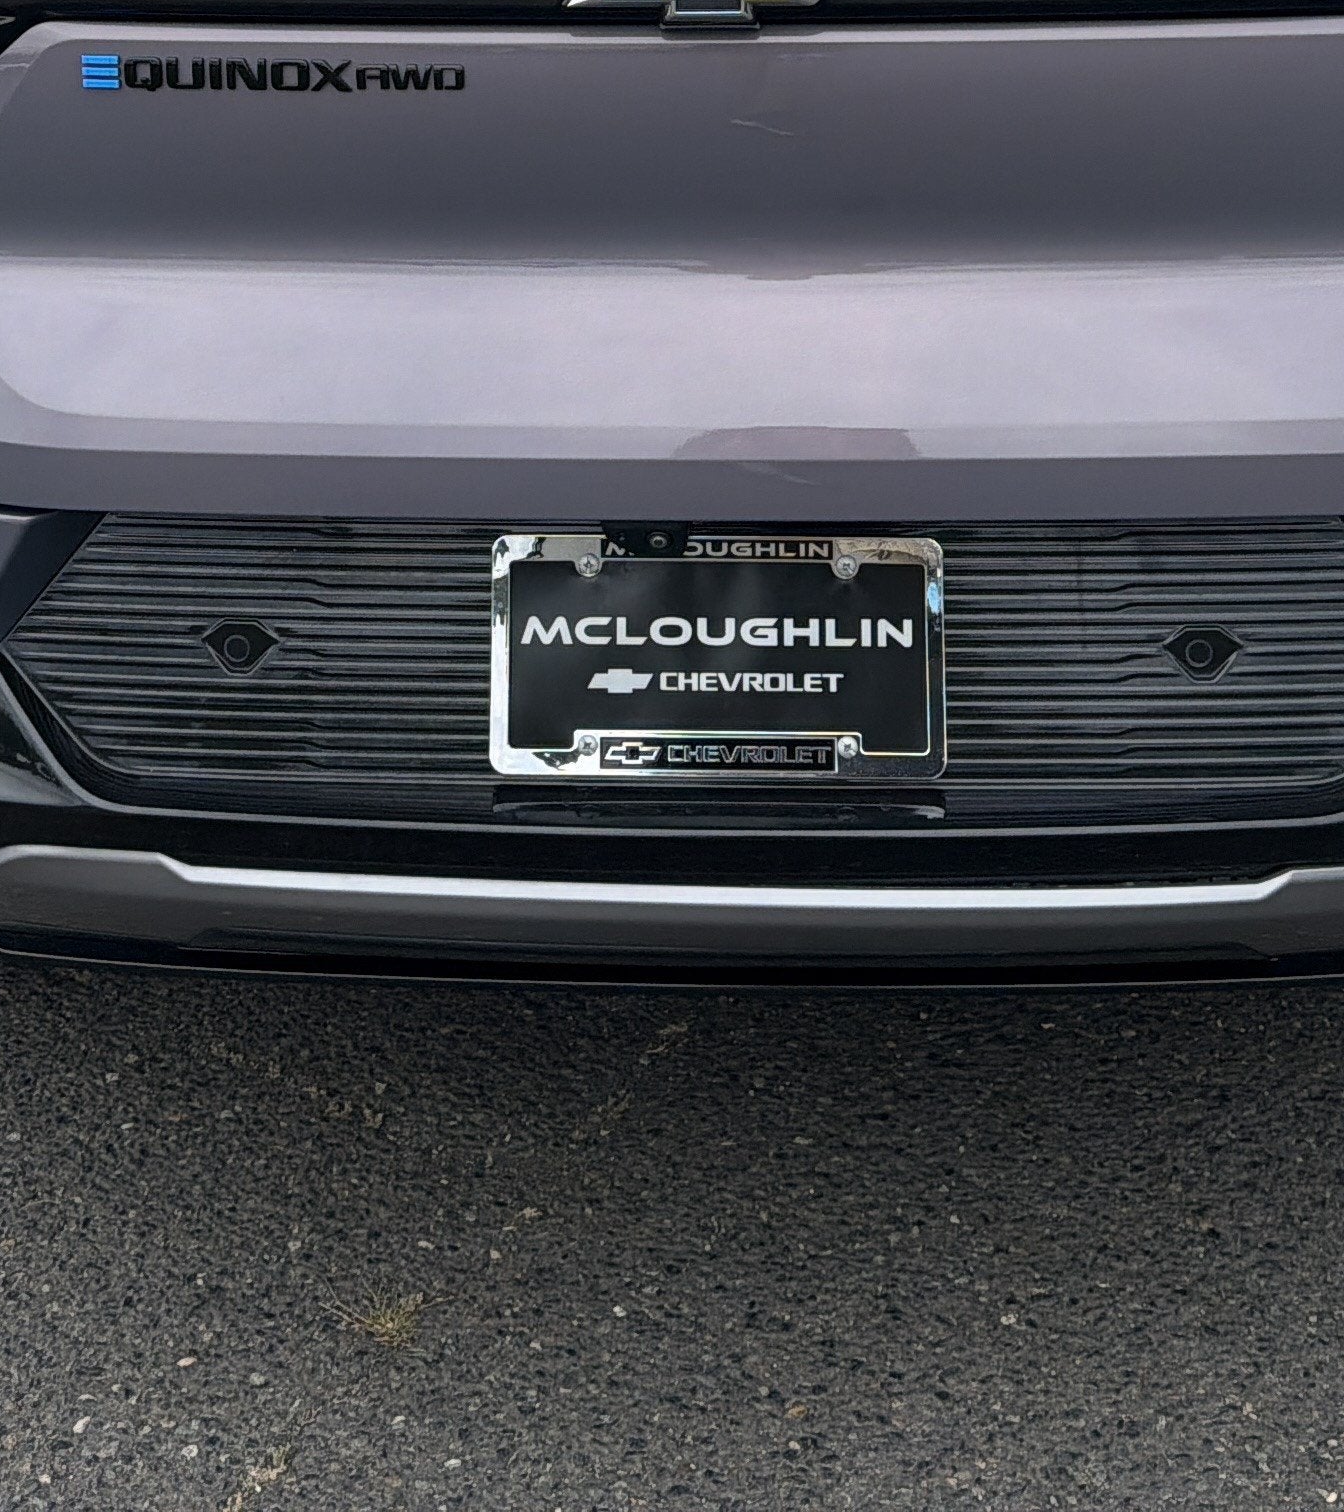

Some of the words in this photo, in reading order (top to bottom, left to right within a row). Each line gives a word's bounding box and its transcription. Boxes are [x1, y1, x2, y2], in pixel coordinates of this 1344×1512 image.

[81, 54, 353, 93] EQUINOX
[356, 62, 466, 92] AWD
[605, 541, 830, 558] MOUGHLIN
[520, 615, 914, 648] MCLOUGHLIN
[659, 671, 845, 694] CHEVROLET
[667, 744, 832, 764] CHEVROLET
